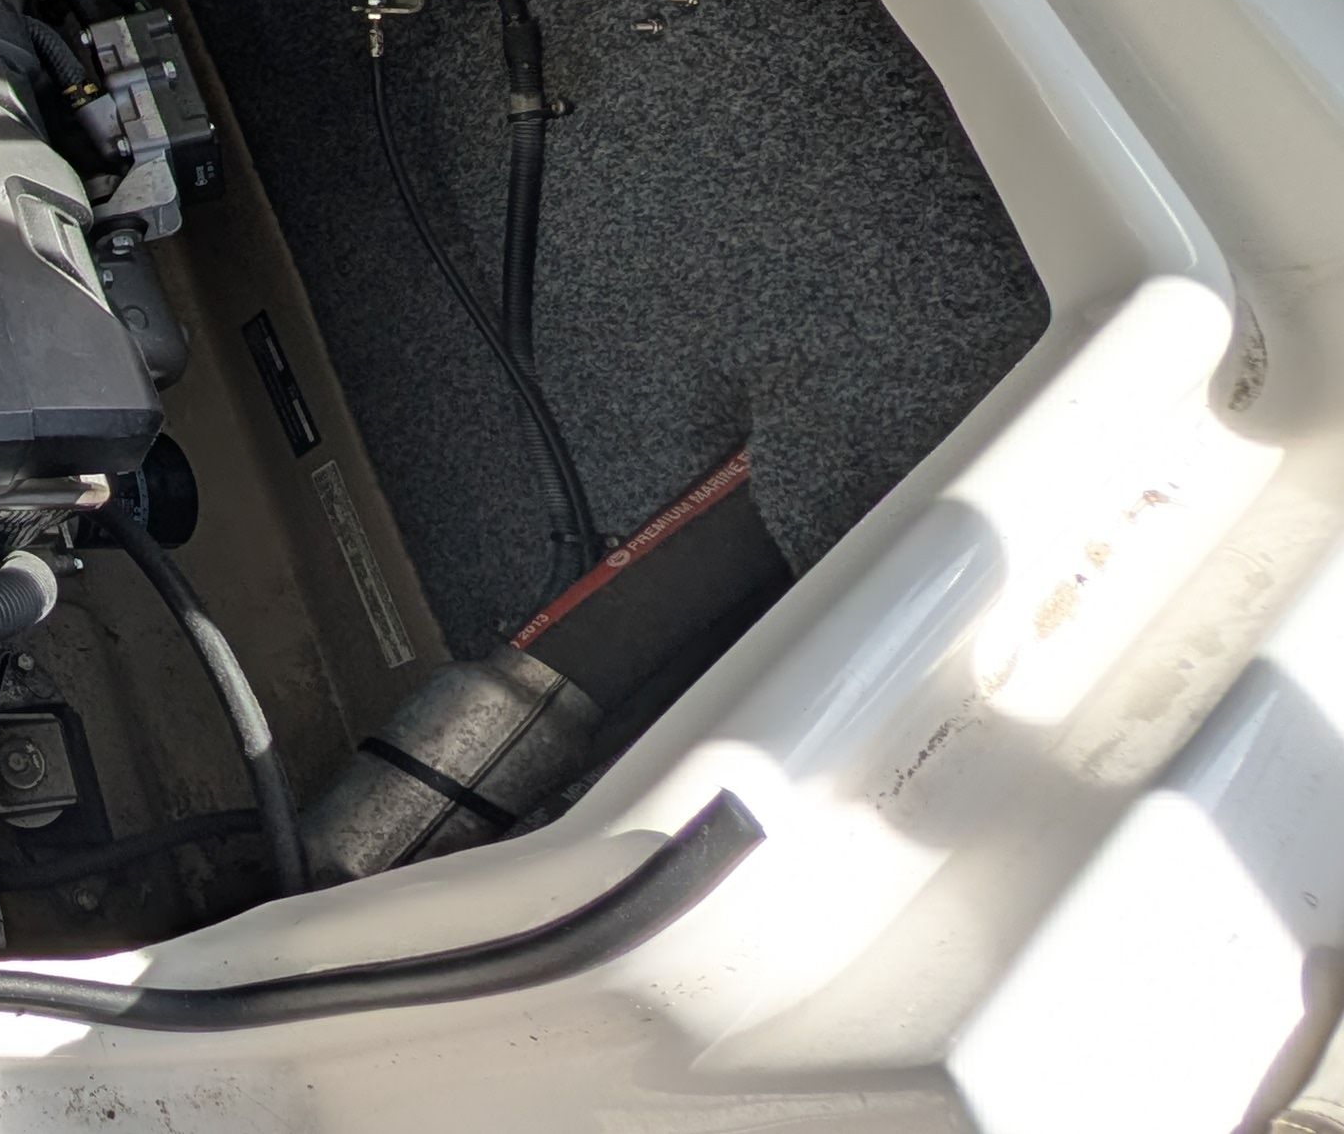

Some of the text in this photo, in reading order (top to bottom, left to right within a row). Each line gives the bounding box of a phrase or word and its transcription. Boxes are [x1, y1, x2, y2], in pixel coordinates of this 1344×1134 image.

[627, 461, 746, 552] PREMIUM MARINE
[517, 613, 550, 641] 2013
